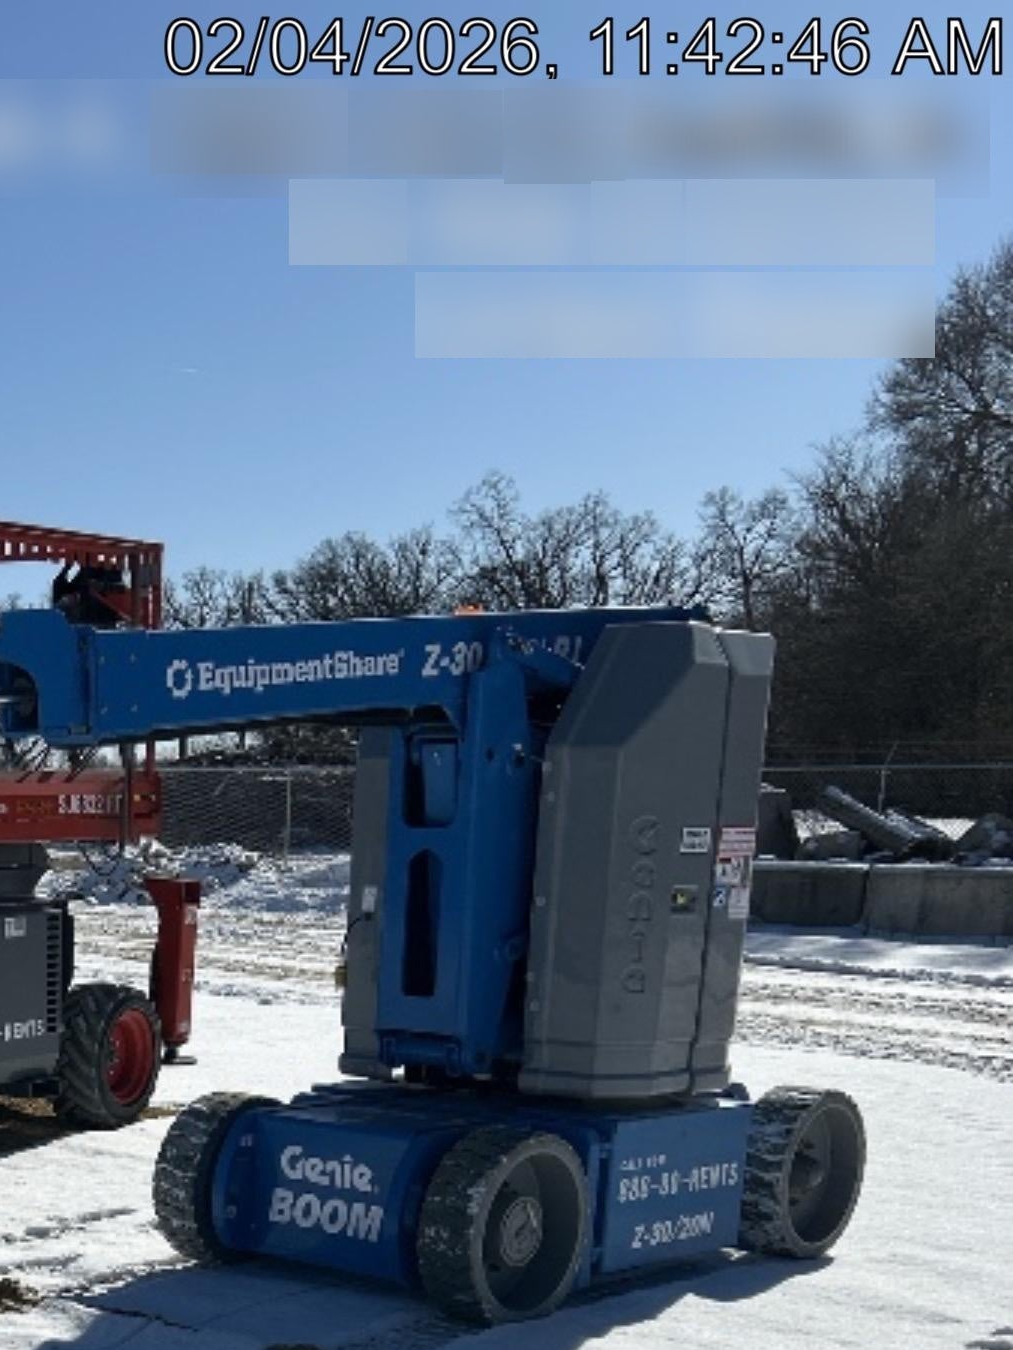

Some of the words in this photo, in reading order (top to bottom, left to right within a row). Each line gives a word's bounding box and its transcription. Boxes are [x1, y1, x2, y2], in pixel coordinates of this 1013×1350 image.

[197, 650, 400, 695] EquipmentShare
[280, 1145, 372, 1192] Genie
[269, 1187, 384, 1243] BOOM
